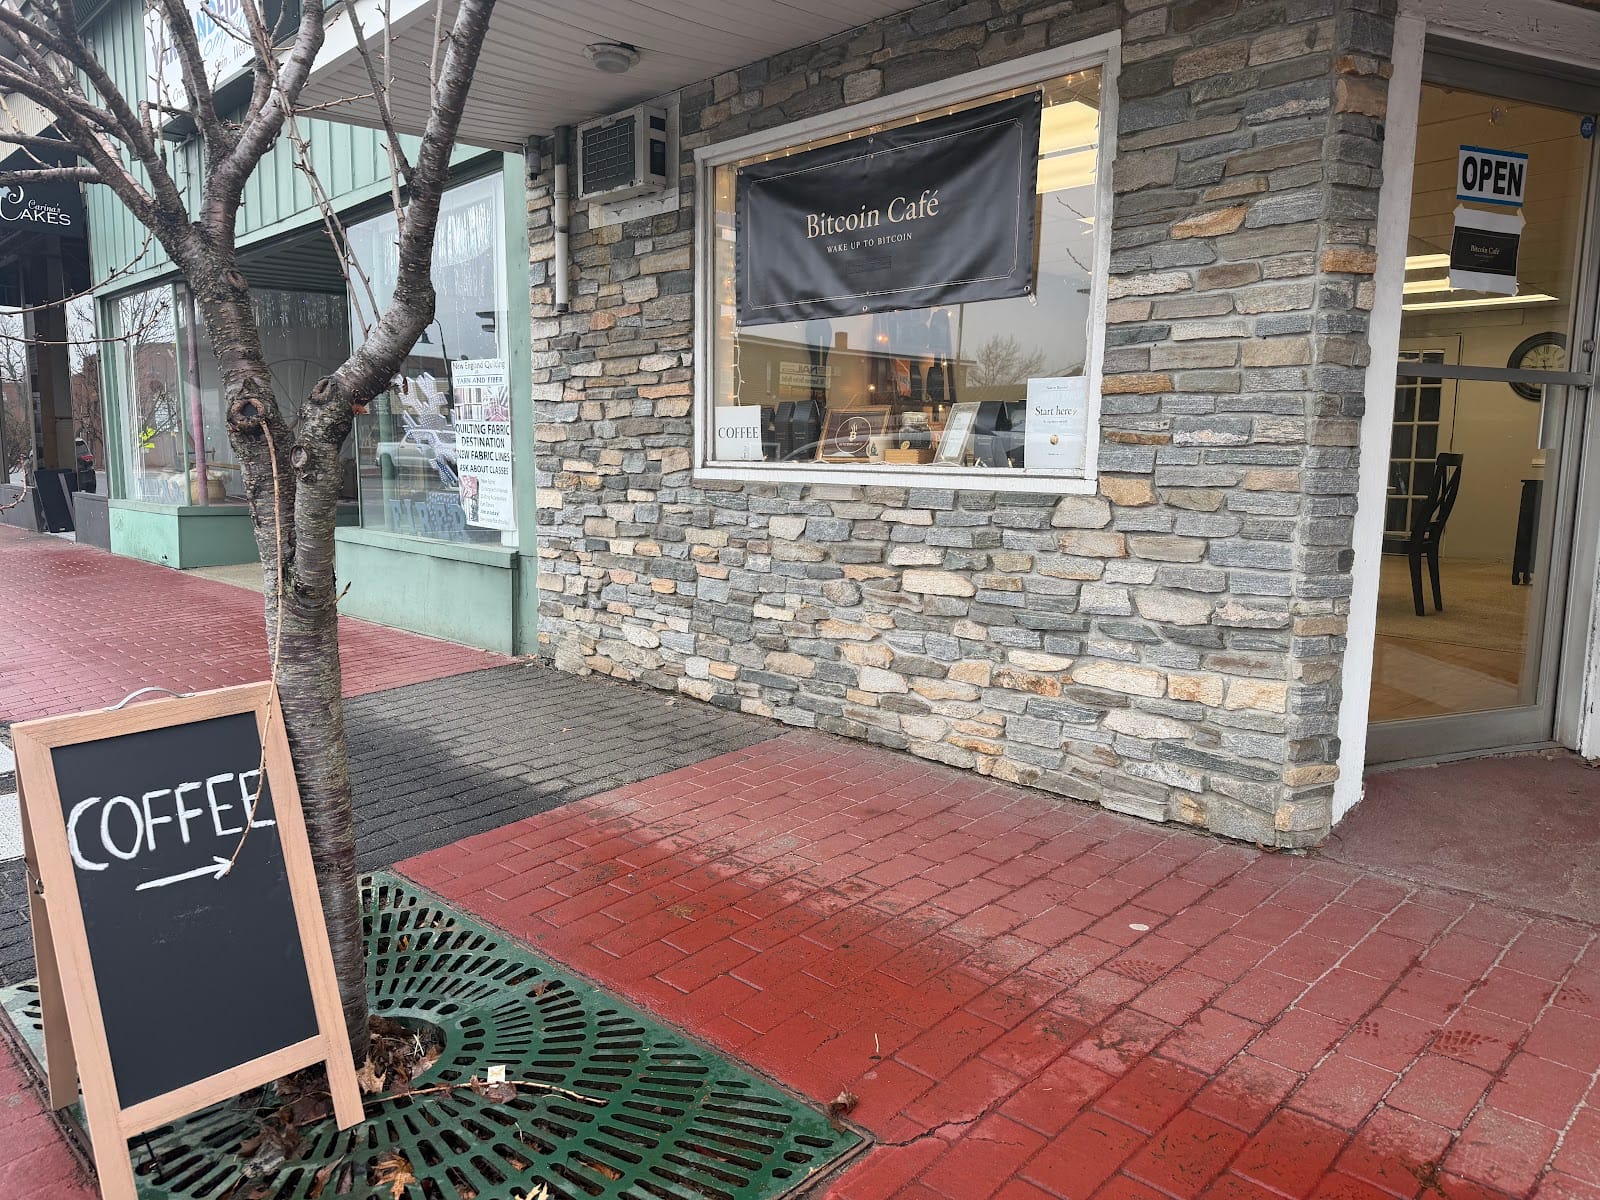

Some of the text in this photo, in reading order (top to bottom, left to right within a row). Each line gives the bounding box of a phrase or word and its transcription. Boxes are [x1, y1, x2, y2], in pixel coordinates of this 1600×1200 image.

[1462, 156, 1524, 197] OPEN
[0, 185, 71, 226] CAKES
[28, 199, 61, 214] Carina's
[806, 189, 939, 239] Bitcoin Café
[827, 232, 913, 254] WAKE UP TO BITCOIN
[456, 376, 471, 385] YARN
[472, 376, 486, 385] AND
[1035, 405, 1054, 416] Start
[455, 423, 510, 436] QUILTING FABRIC
[717, 425, 760, 439] COFFEE
[461, 436, 505, 449] DESTINATION
[456, 449, 511, 463] NEW FABRIC LINES
[460, 464, 510, 476] ASK ABOUT CLASSES
[67, 768, 276, 870] COFFEE
